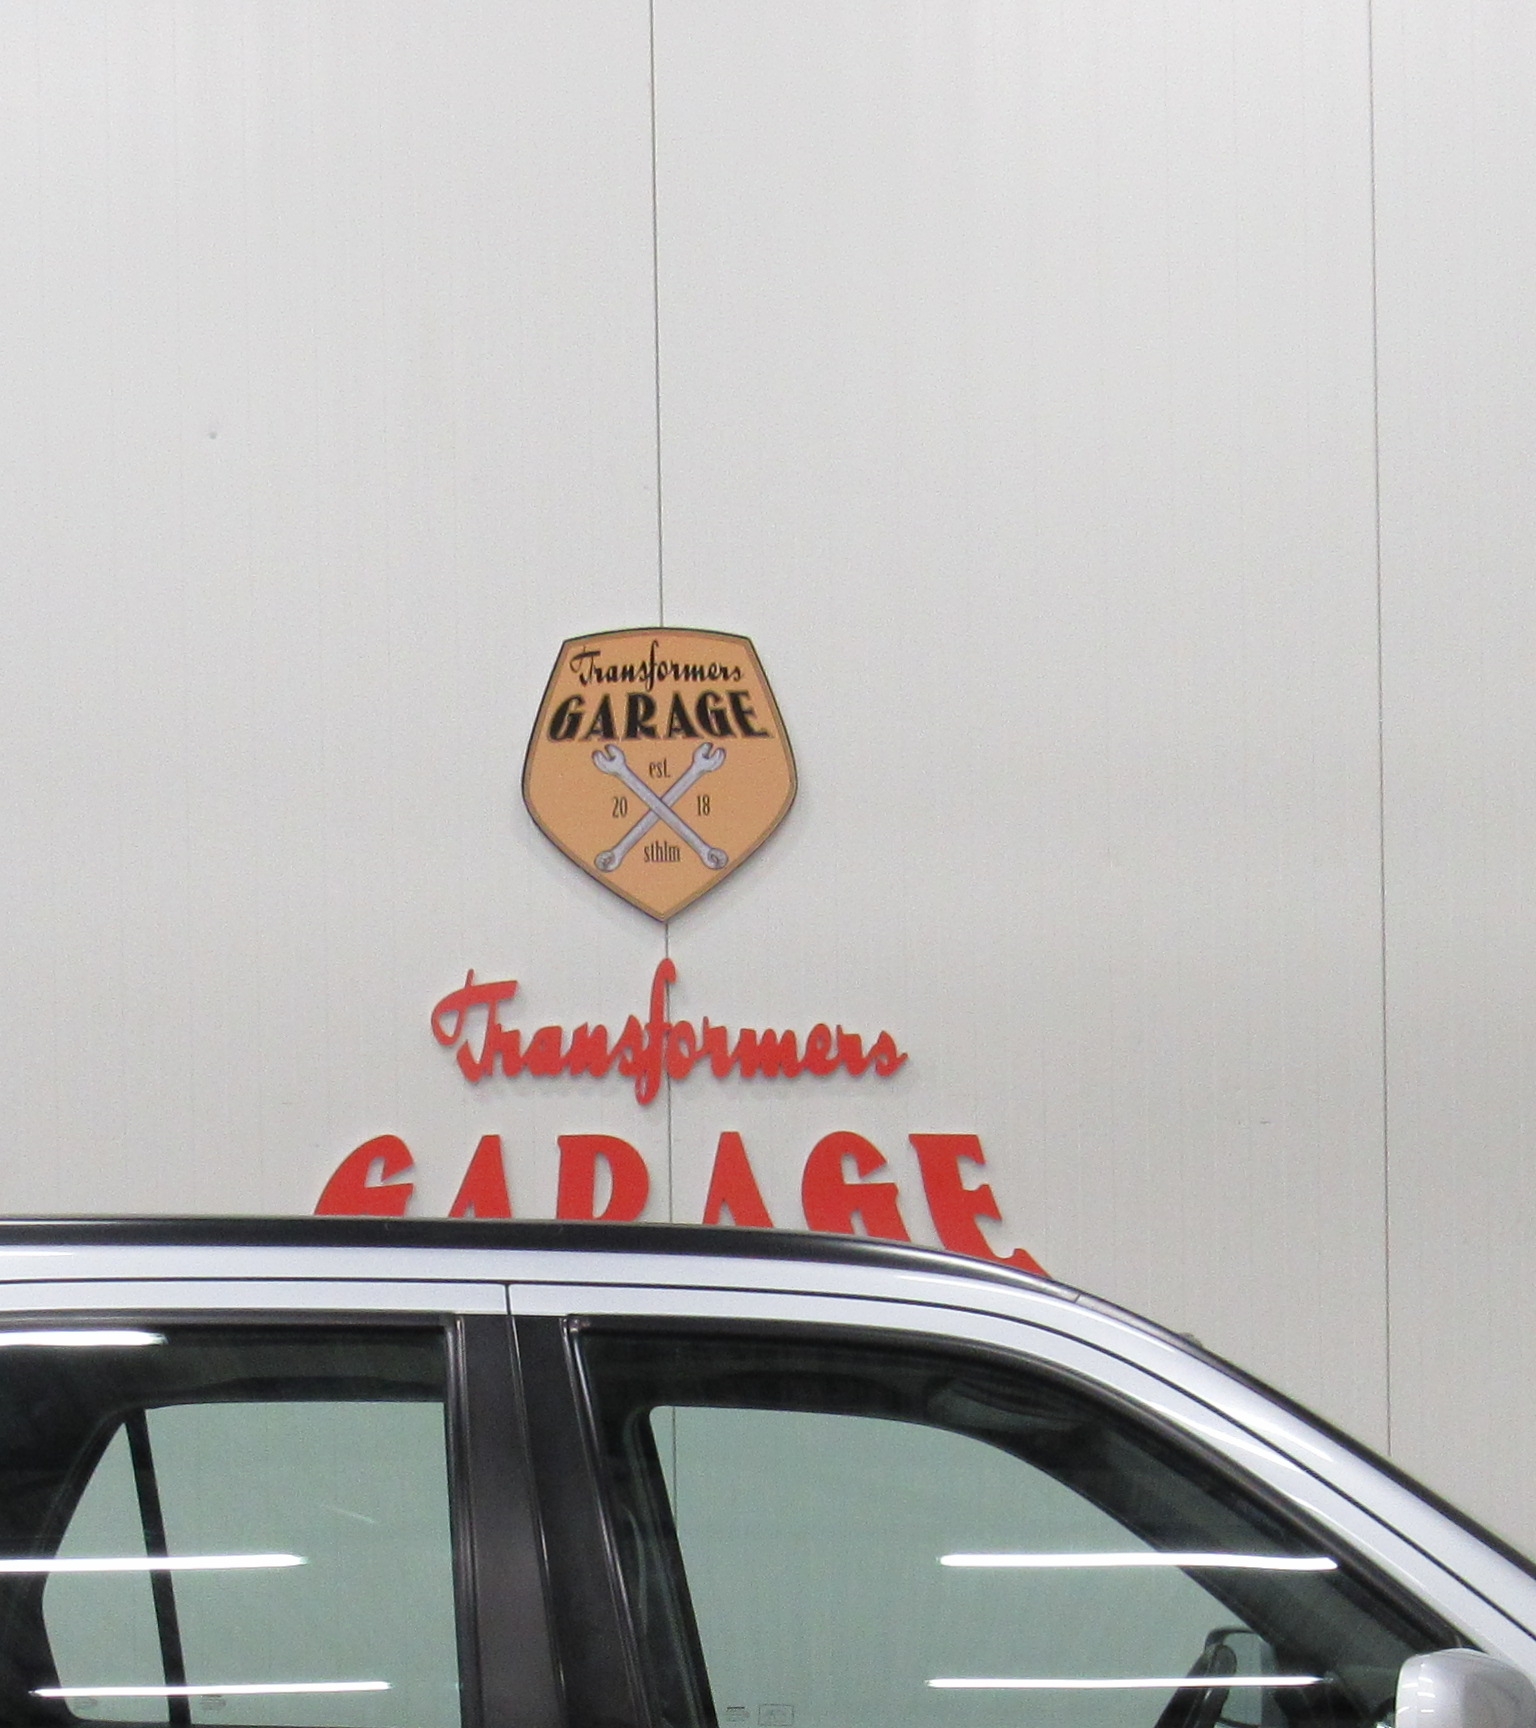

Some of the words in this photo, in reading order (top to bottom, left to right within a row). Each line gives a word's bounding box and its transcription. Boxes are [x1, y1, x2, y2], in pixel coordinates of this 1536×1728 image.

[569, 640, 744, 692] Transformers
[547, 690, 773, 741] GARAGE
[648, 757, 671, 779] est.
[611, 796, 628, 818] 20
[696, 795, 710, 817] 18
[643, 840, 681, 863] sthlm
[430, 957, 908, 1106] Transformers
